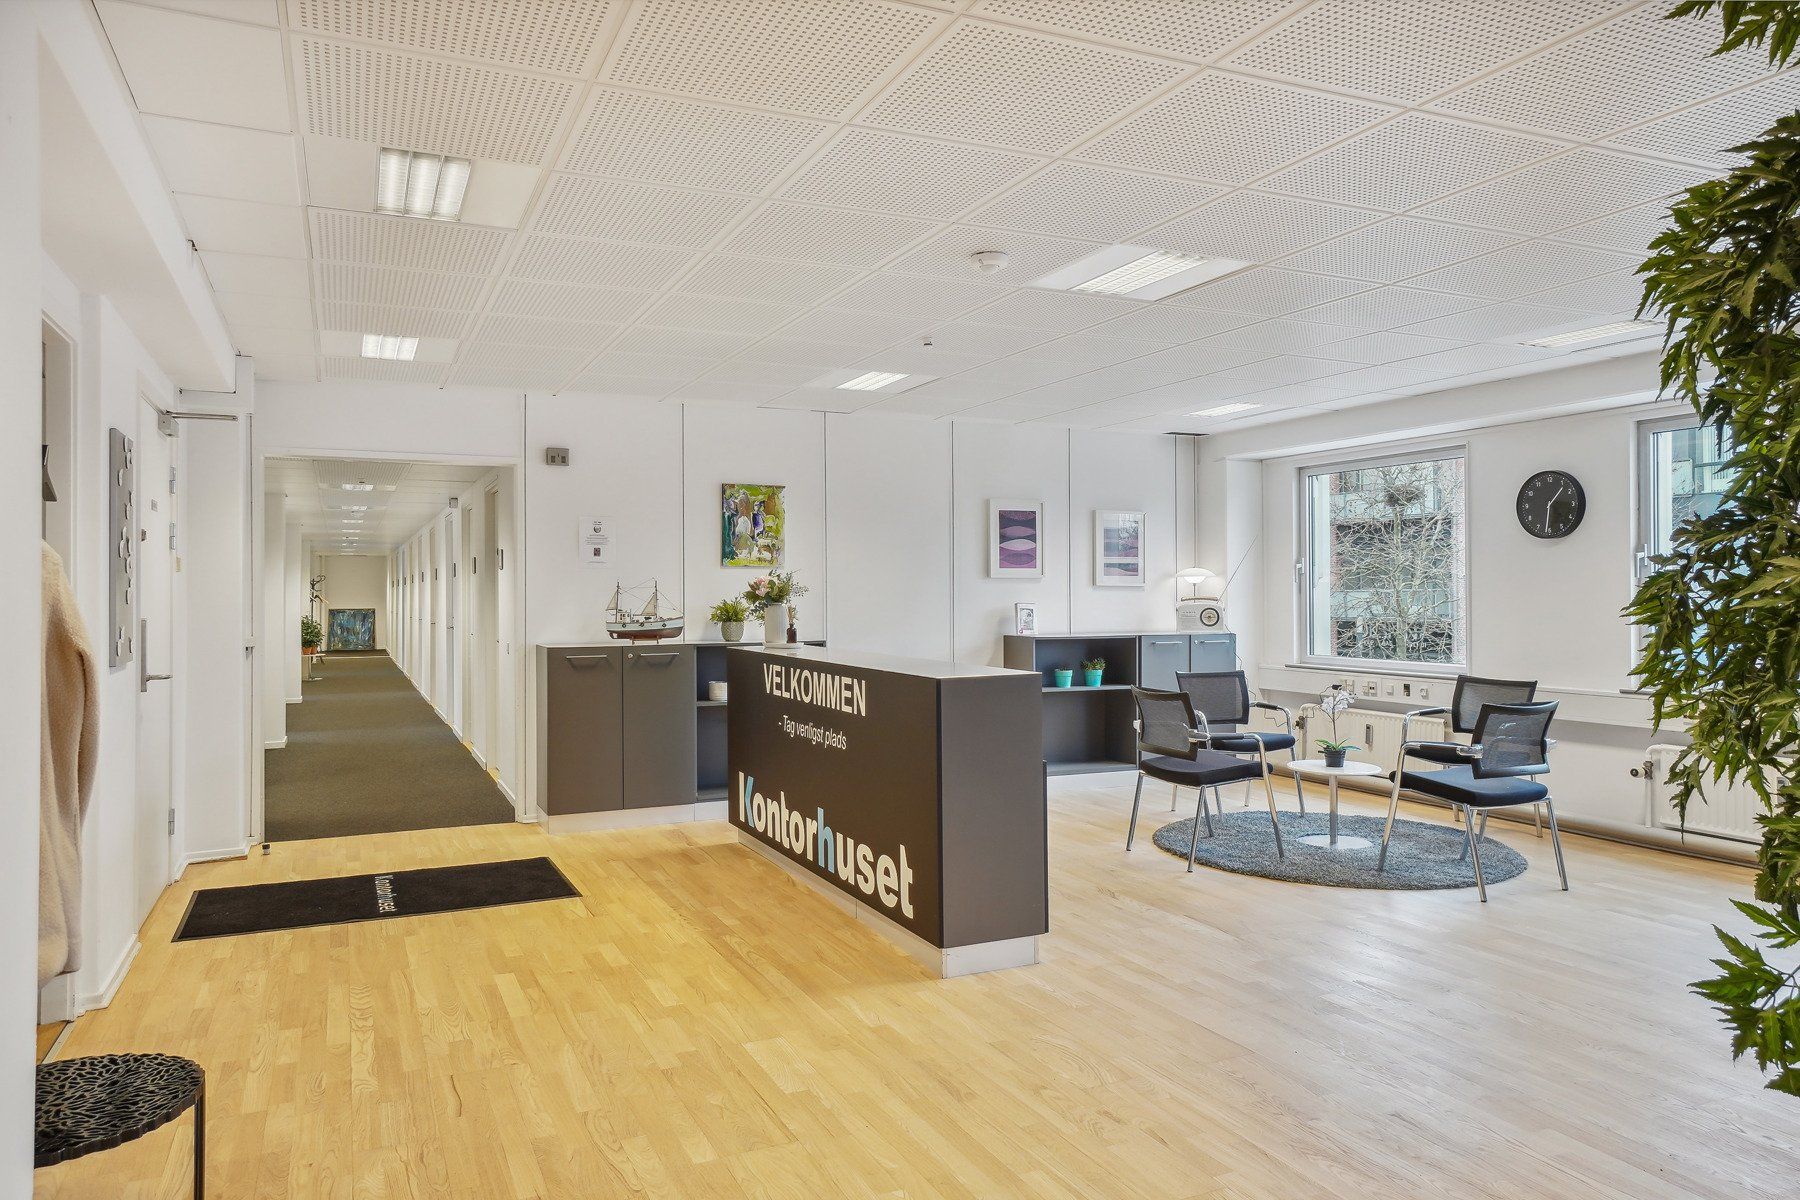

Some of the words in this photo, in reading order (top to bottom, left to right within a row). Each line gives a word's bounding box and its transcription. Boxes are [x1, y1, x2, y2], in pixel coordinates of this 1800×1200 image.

[763, 663, 866, 717] VELKOMMEN
[783, 714, 795, 738] Tag
[796, 722, 824, 745] venligst
[825, 728, 847, 750] plads
[738, 771, 914, 919] Kontorhuset
